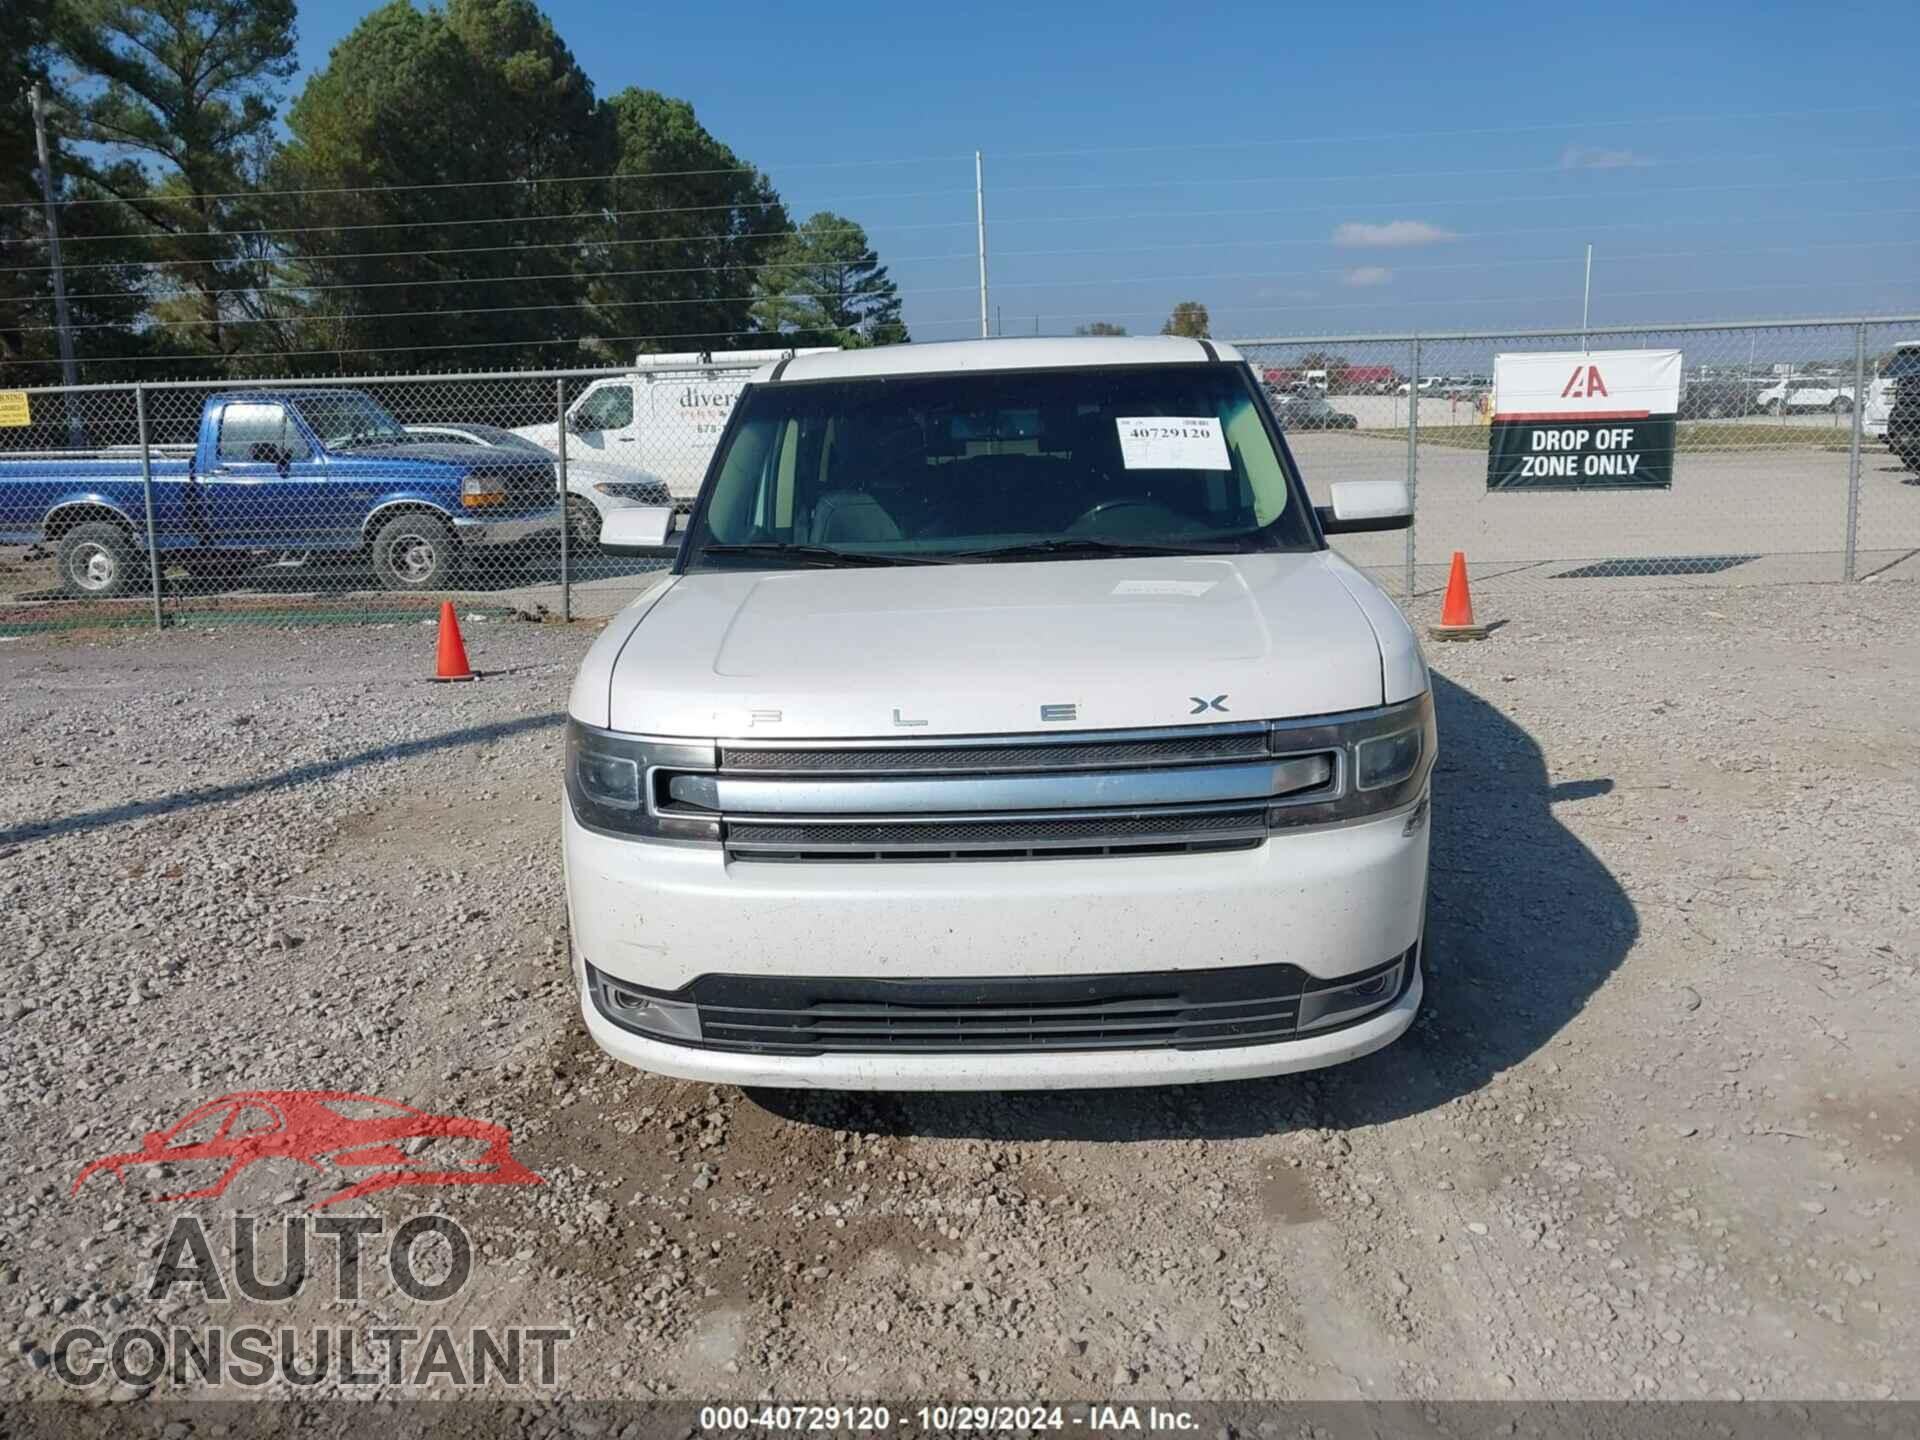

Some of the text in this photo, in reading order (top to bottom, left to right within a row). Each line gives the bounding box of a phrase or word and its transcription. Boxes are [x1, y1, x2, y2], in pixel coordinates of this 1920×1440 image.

[1130, 427, 1211, 439] 40729120
[1532, 428, 1634, 451] DROP OFF
[1521, 454, 1641, 477] ZONE ONLY
